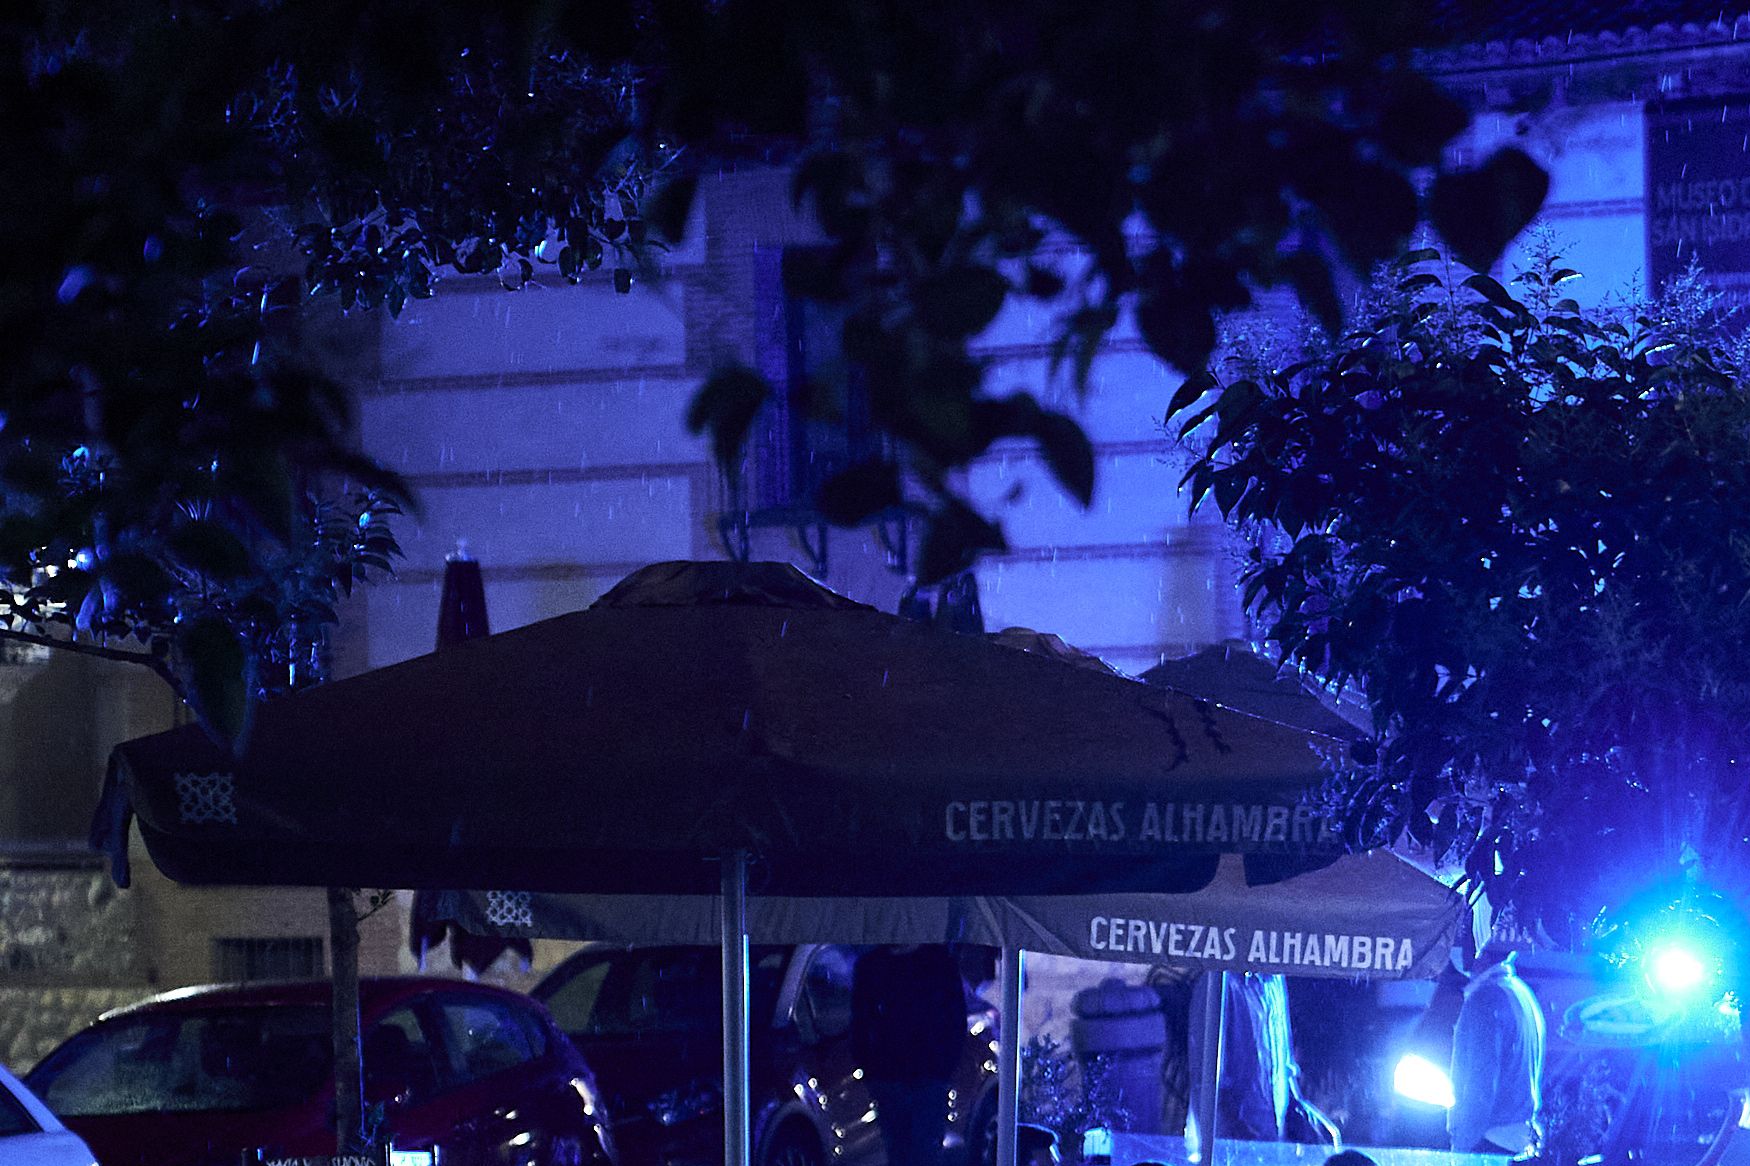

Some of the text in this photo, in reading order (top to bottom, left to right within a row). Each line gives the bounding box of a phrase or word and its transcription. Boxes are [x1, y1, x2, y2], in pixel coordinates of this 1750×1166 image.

[1657, 179, 1735, 210] MUSEO
[1652, 215, 1697, 245] SAN
[945, 800, 1338, 843] CERVEZAS ALHAMBRA
[1090, 915, 1413, 970] CERVEZAS ALHAMBRA
